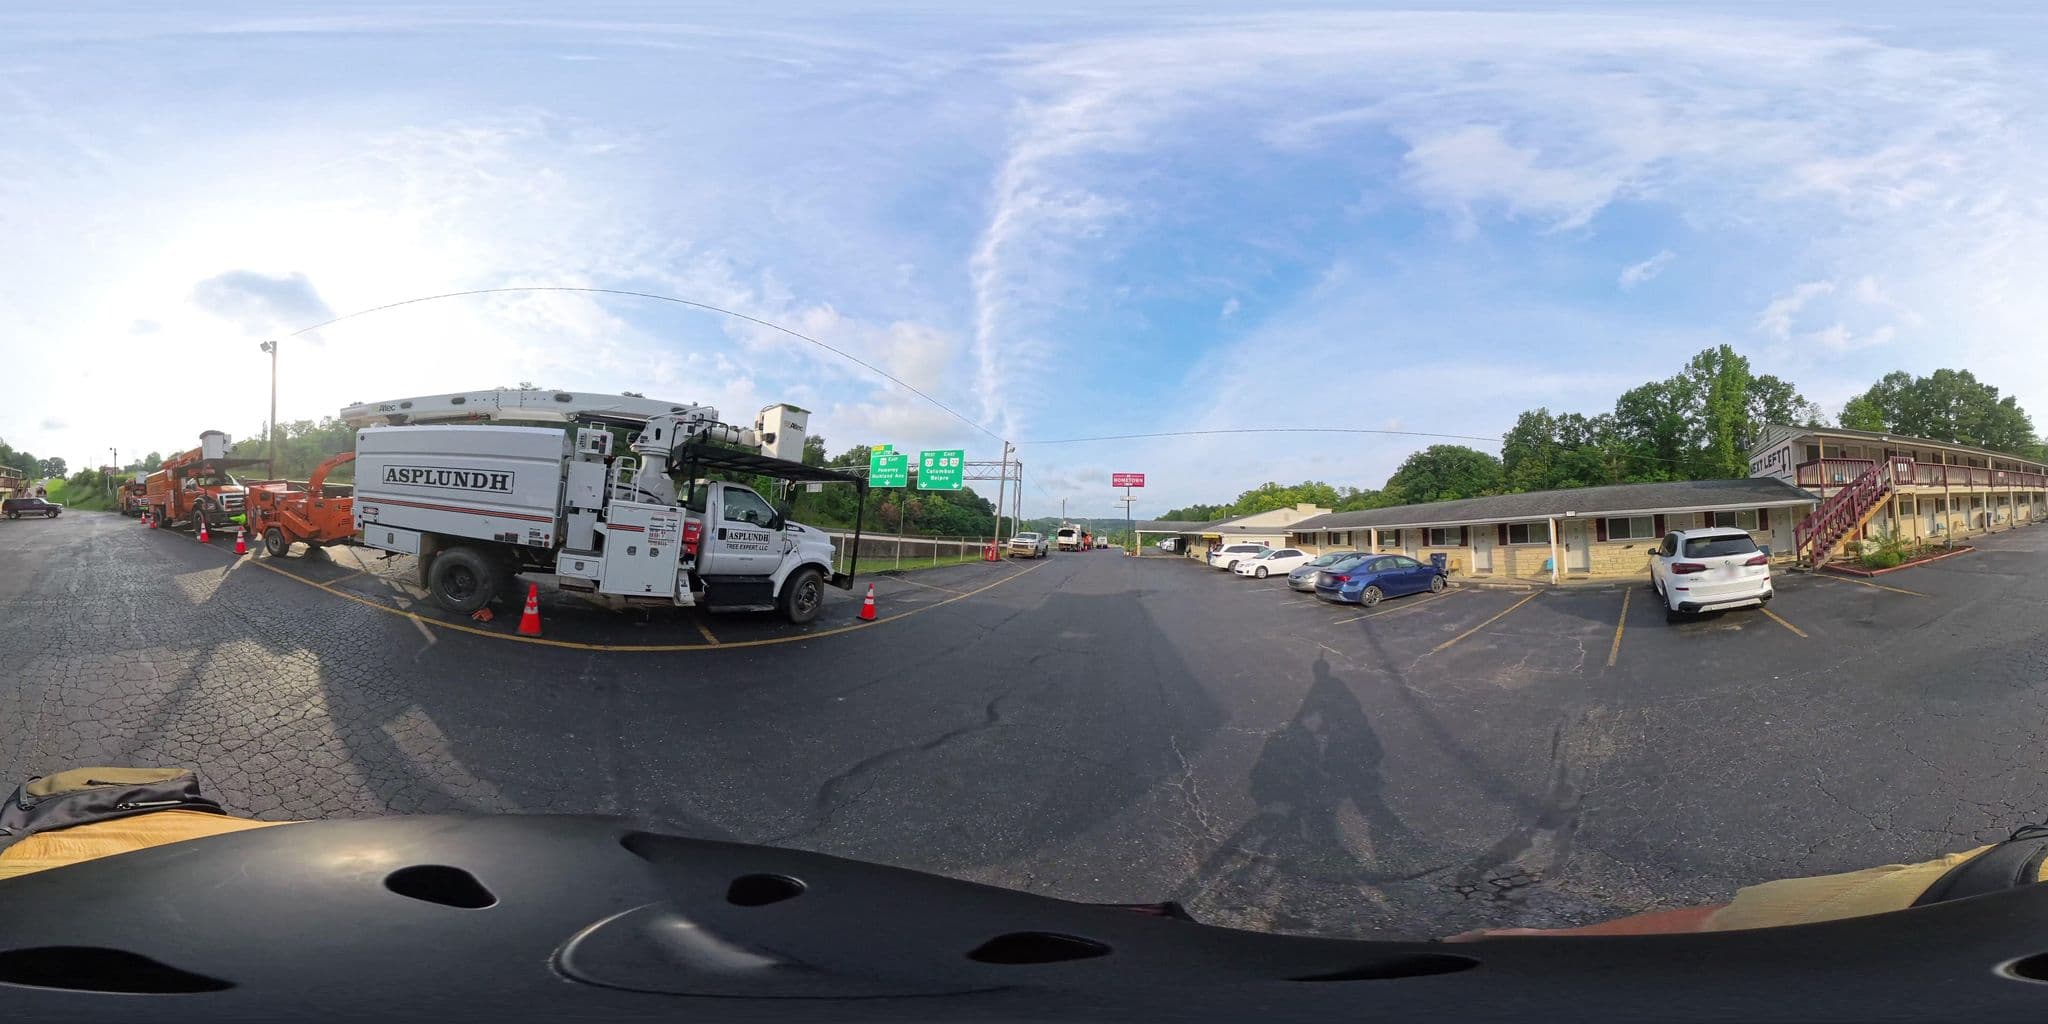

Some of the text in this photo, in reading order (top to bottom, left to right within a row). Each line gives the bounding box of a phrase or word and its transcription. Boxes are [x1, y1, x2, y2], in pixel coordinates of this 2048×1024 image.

[1764, 450, 1781, 469] LEFT
[386, 468, 509, 491] ASPLUNDH
[728, 531, 769, 542] ASPLUNDH
